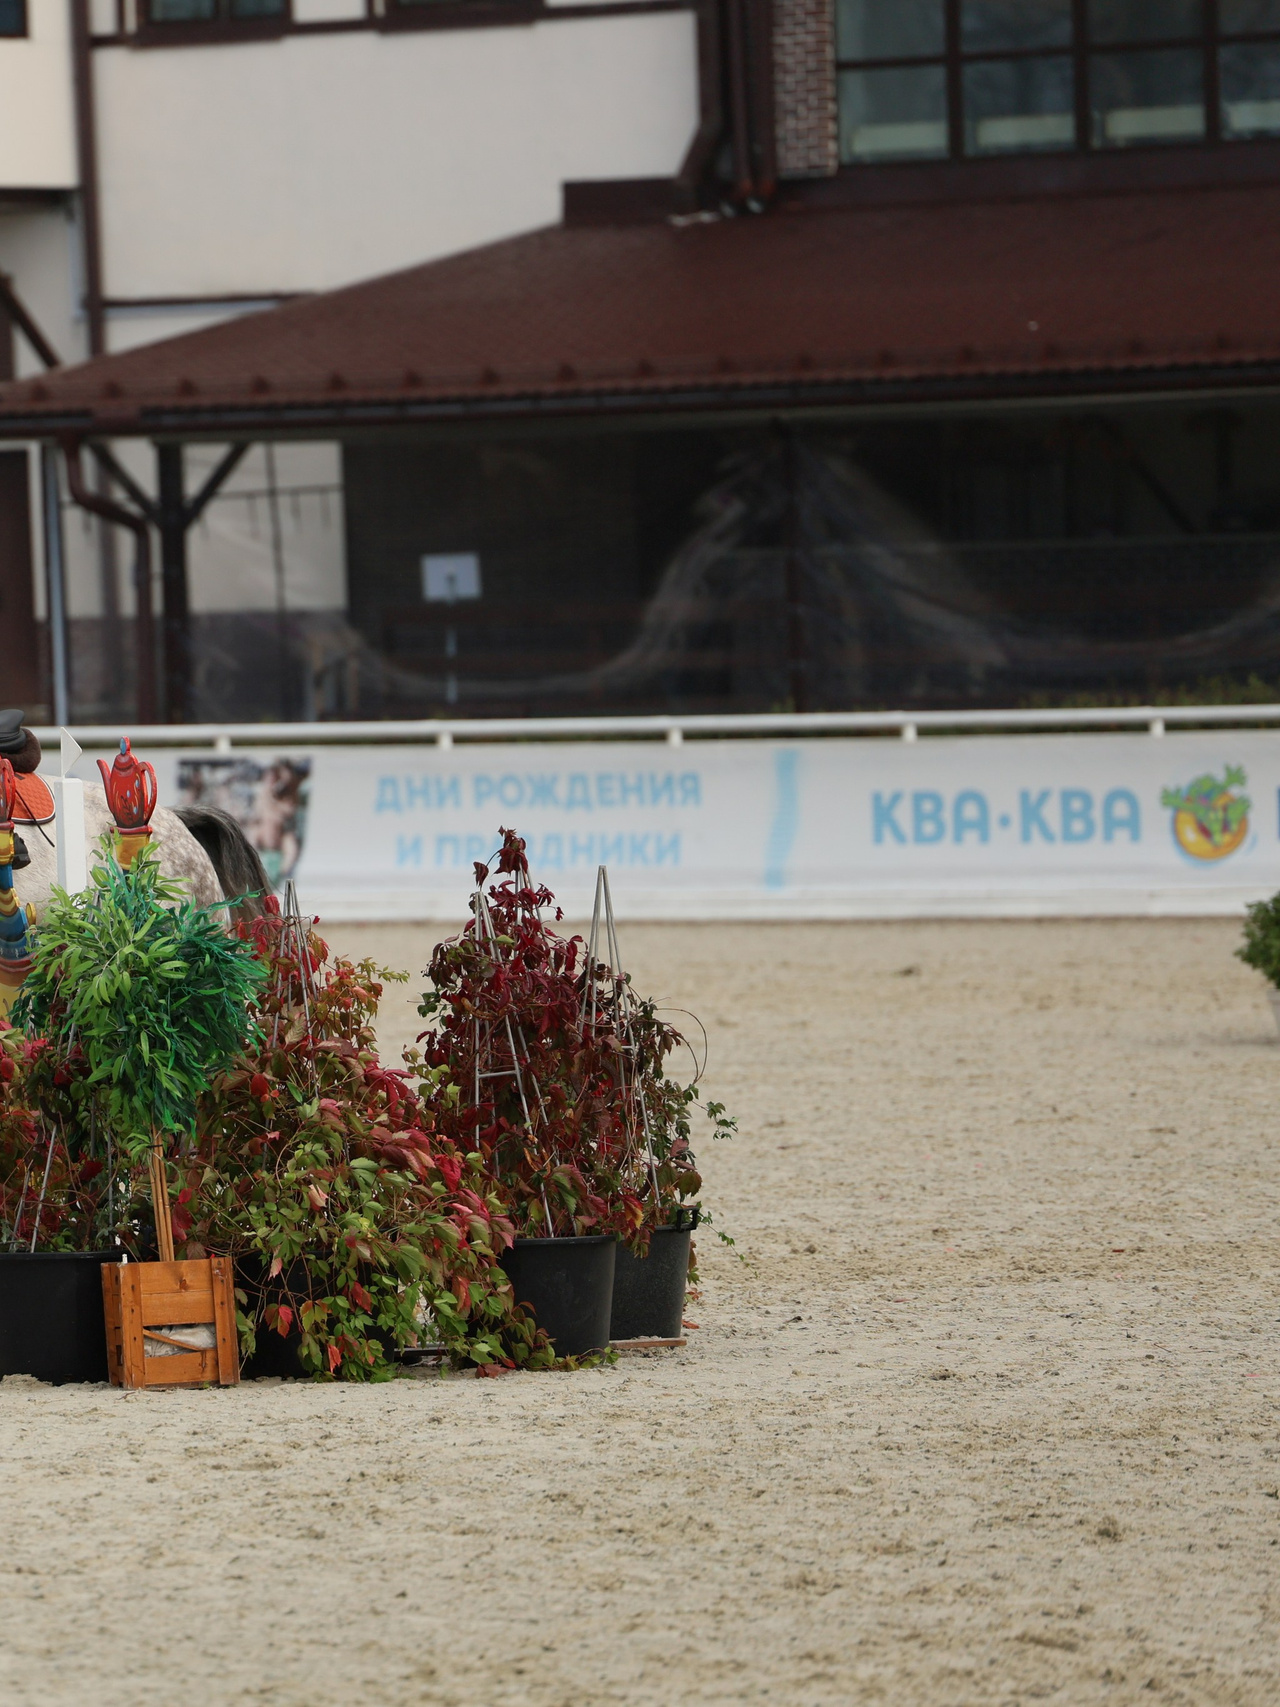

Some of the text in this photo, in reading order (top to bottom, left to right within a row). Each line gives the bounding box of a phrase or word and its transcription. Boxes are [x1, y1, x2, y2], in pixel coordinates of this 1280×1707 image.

[375, 770, 702, 814] ДНИ РОЖДЕНИЯ
[396, 834, 421, 867] И
